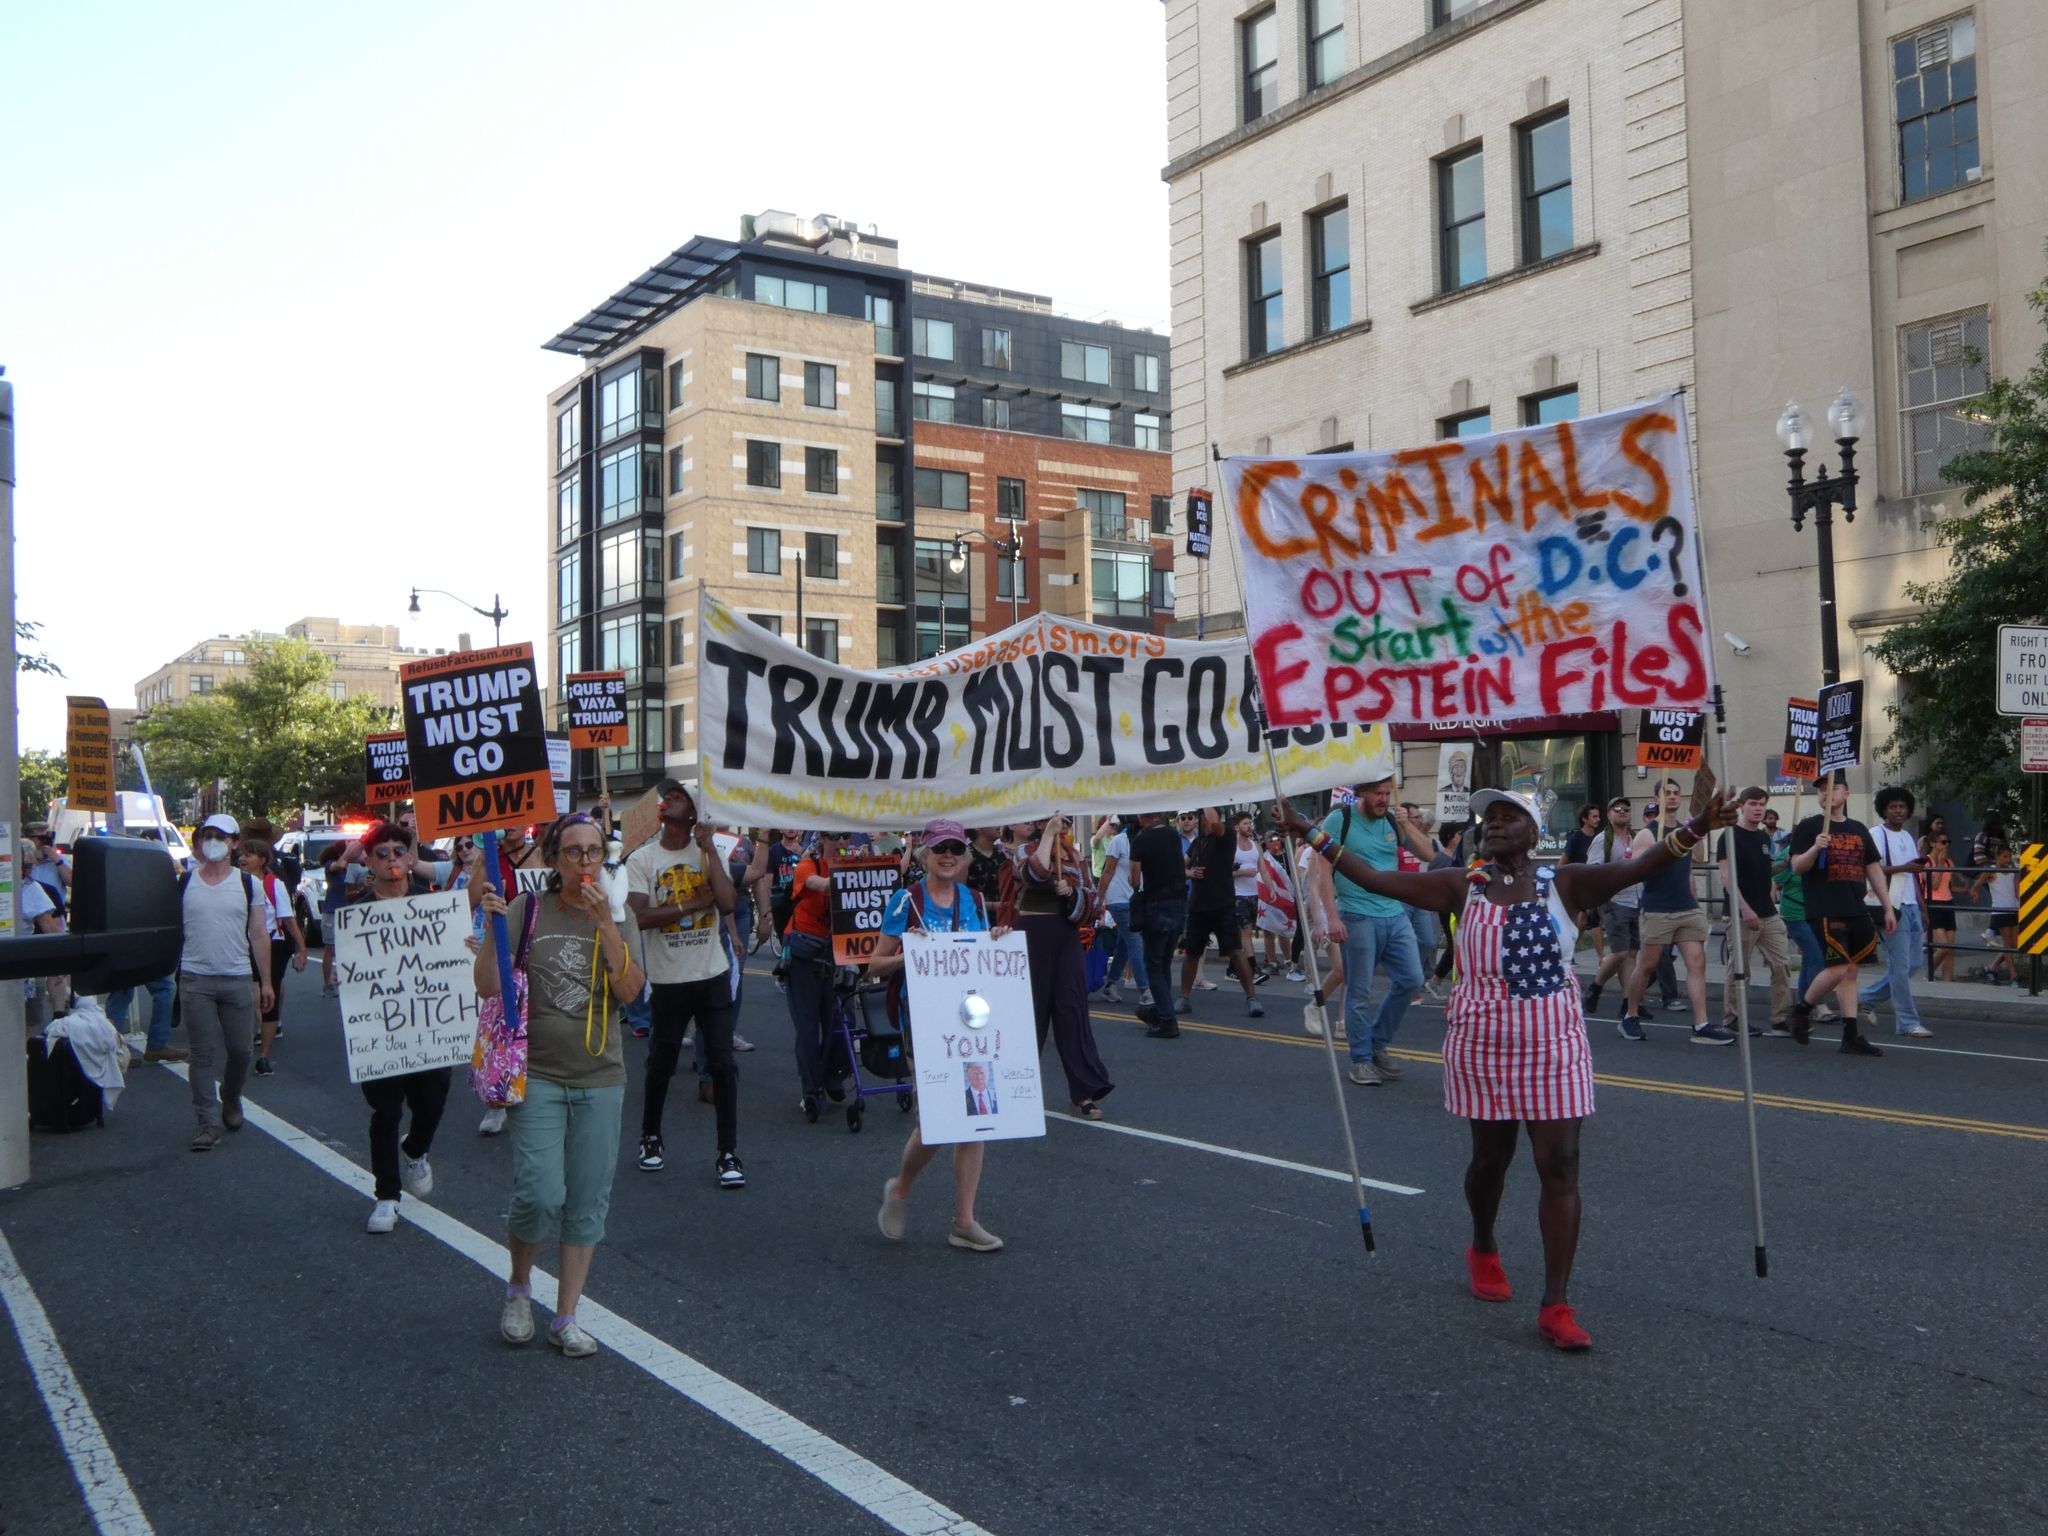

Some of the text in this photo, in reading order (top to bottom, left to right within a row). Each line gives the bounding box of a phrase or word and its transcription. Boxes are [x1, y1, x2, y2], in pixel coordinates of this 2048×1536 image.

[1300, 567, 1432, 618] OUT
[1329, 598, 1471, 664] Start
[1498, 590, 1595, 647] the
[2010, 635, 2039, 648] RIGHT
[407, 645, 523, 675] RefuseFascism.org
[2020, 653, 2047, 668] FRO
[2006, 673, 2038, 685] RIGHT
[408, 667, 532, 714] TRUMP
[568, 681, 625, 699] ¡QUE SE
[579, 696, 616, 710] VAYA
[705, 640, 949, 780] TRUMP
[962, 651, 1125, 775] MUST
[1141, 655, 1229, 765] GO
[424, 702, 522, 747] MUST
[573, 711, 624, 725] TRUMP
[1649, 710, 1698, 727] MUST
[1789, 707, 1819, 725] TRUM
[588, 729, 613, 743] YA!
[1659, 726, 1684, 742] GO
[1790, 723, 1818, 740] MUST
[368, 740, 407, 756] TRUM
[1646, 746, 1694, 763] NOW!
[1794, 740, 1810, 753] GO
[373, 753, 410, 769] MUST
[453, 741, 504, 776] GO
[1788, 758, 1815, 774] NOW!
[383, 767, 403, 781] GO
[375, 782, 411, 799] NOW!
[438, 779, 535, 825] NOW!
[833, 869, 899, 889] TRUMP
[841, 889, 894, 910] MUST
[358, 905, 394, 927] You
[855, 910, 882, 930] GO
[354, 920, 447, 957] TRUMP
[341, 953, 471, 984] Your Momma
[910, 947, 1028, 980] WHO'S NEXT?
[369, 980, 405, 1000] And
[348, 991, 480, 1032] are a BITCH
[430, 1029, 471, 1045] Trump
[942, 1029, 1001, 1060] YOU!
